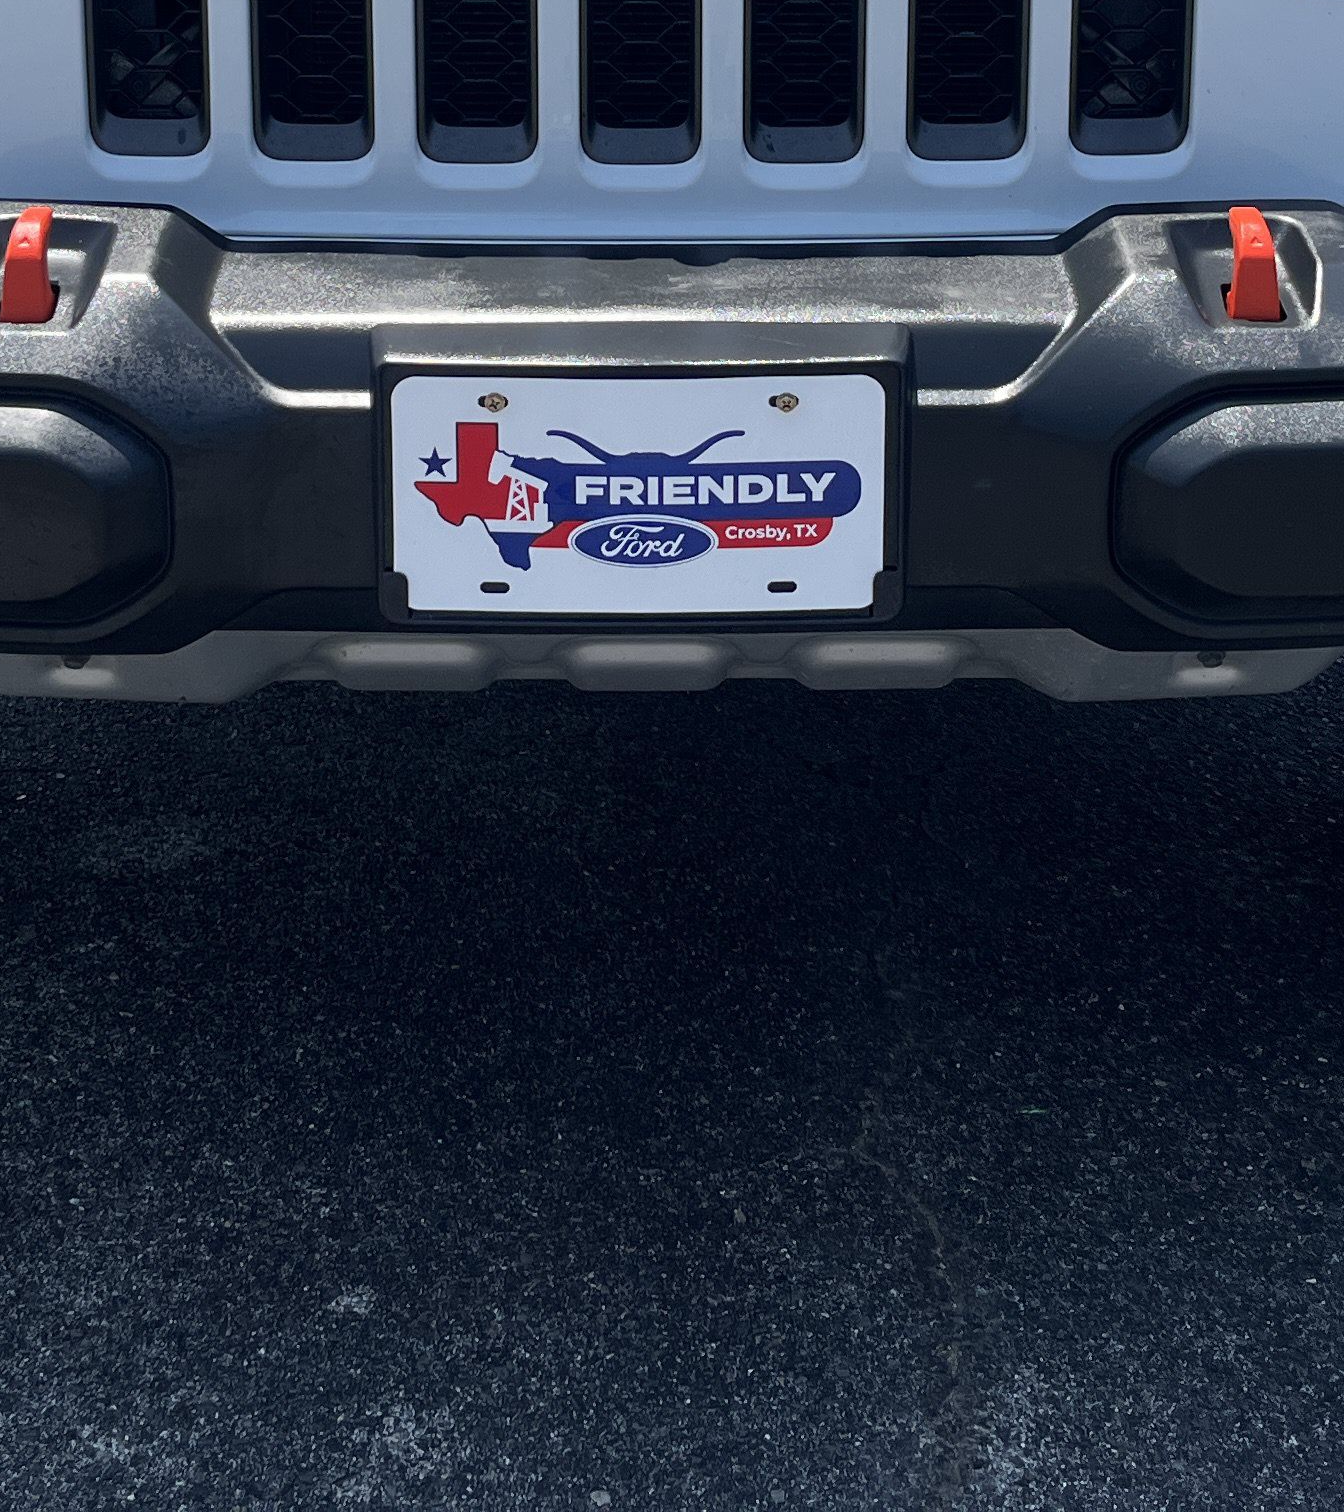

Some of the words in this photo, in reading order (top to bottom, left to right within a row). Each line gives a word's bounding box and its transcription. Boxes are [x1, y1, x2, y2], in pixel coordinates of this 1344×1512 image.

[575, 472, 837, 506] FRIENDLY
[600, 523, 685, 559] Ford
[724, 524, 791, 541] Crosby,
[793, 523, 818, 538] TX
